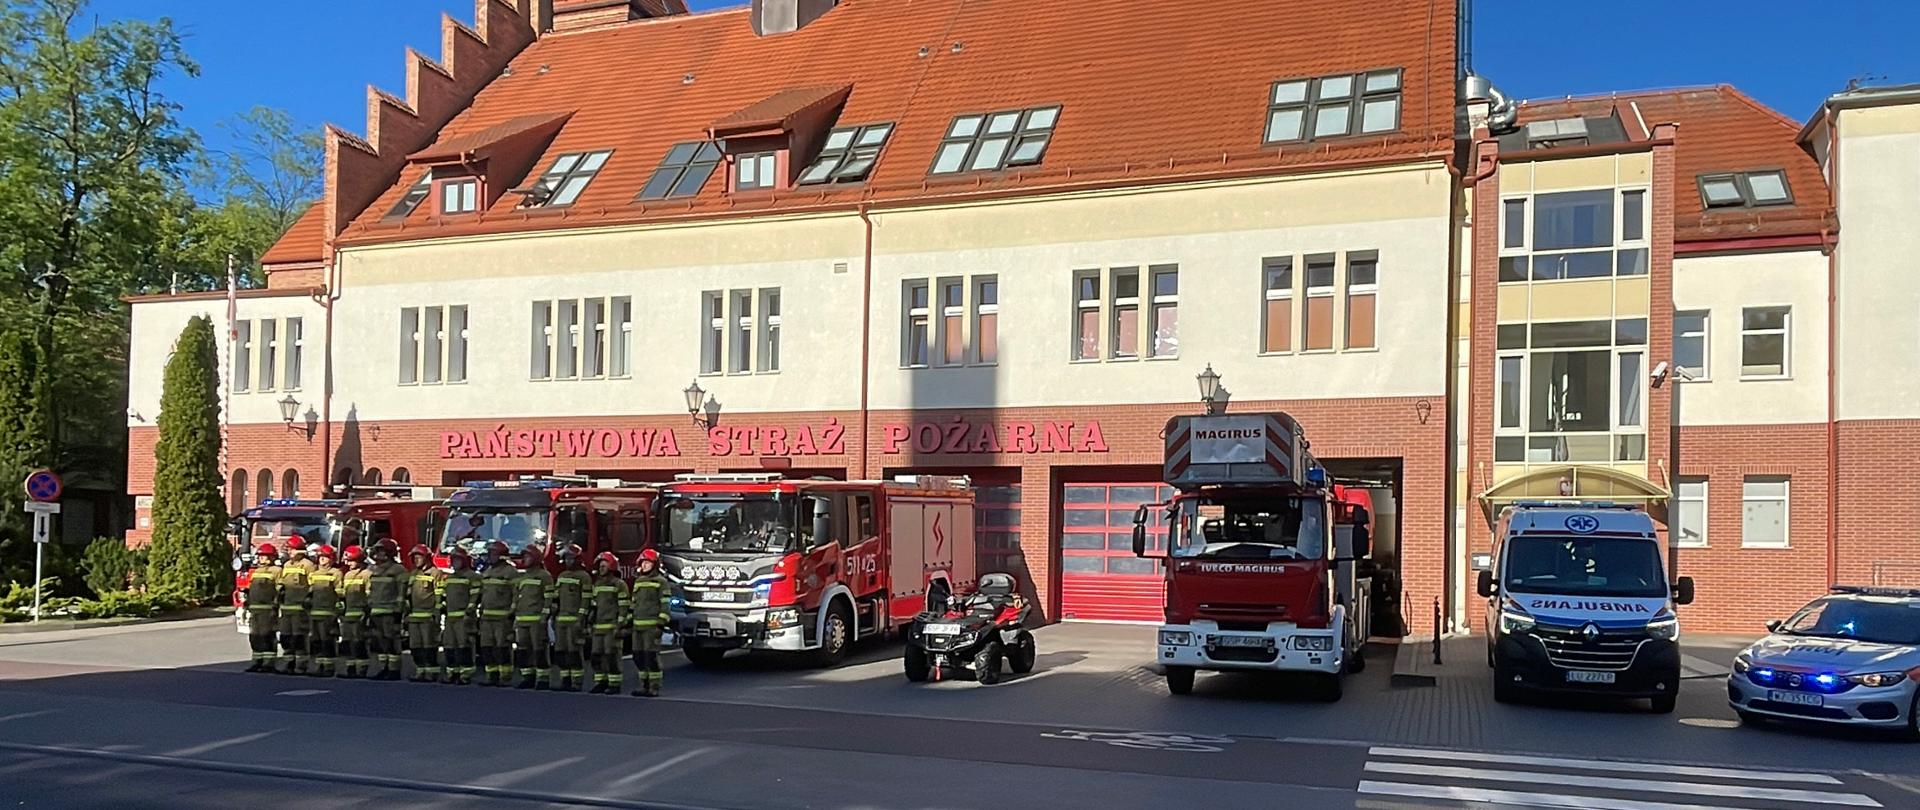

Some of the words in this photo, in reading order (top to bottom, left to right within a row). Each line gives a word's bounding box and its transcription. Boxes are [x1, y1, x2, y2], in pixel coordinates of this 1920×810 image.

[440, 424, 681, 459] PAŃSTWOWA
[708, 418, 847, 458] STRAŻ
[882, 414, 1110, 455] POŻARNA
[1194, 427, 1262, 440] MAGIRUS
[1201, 563, 1233, 573] IVECO
[1235, 564, 1285, 574] MAGIRUS
